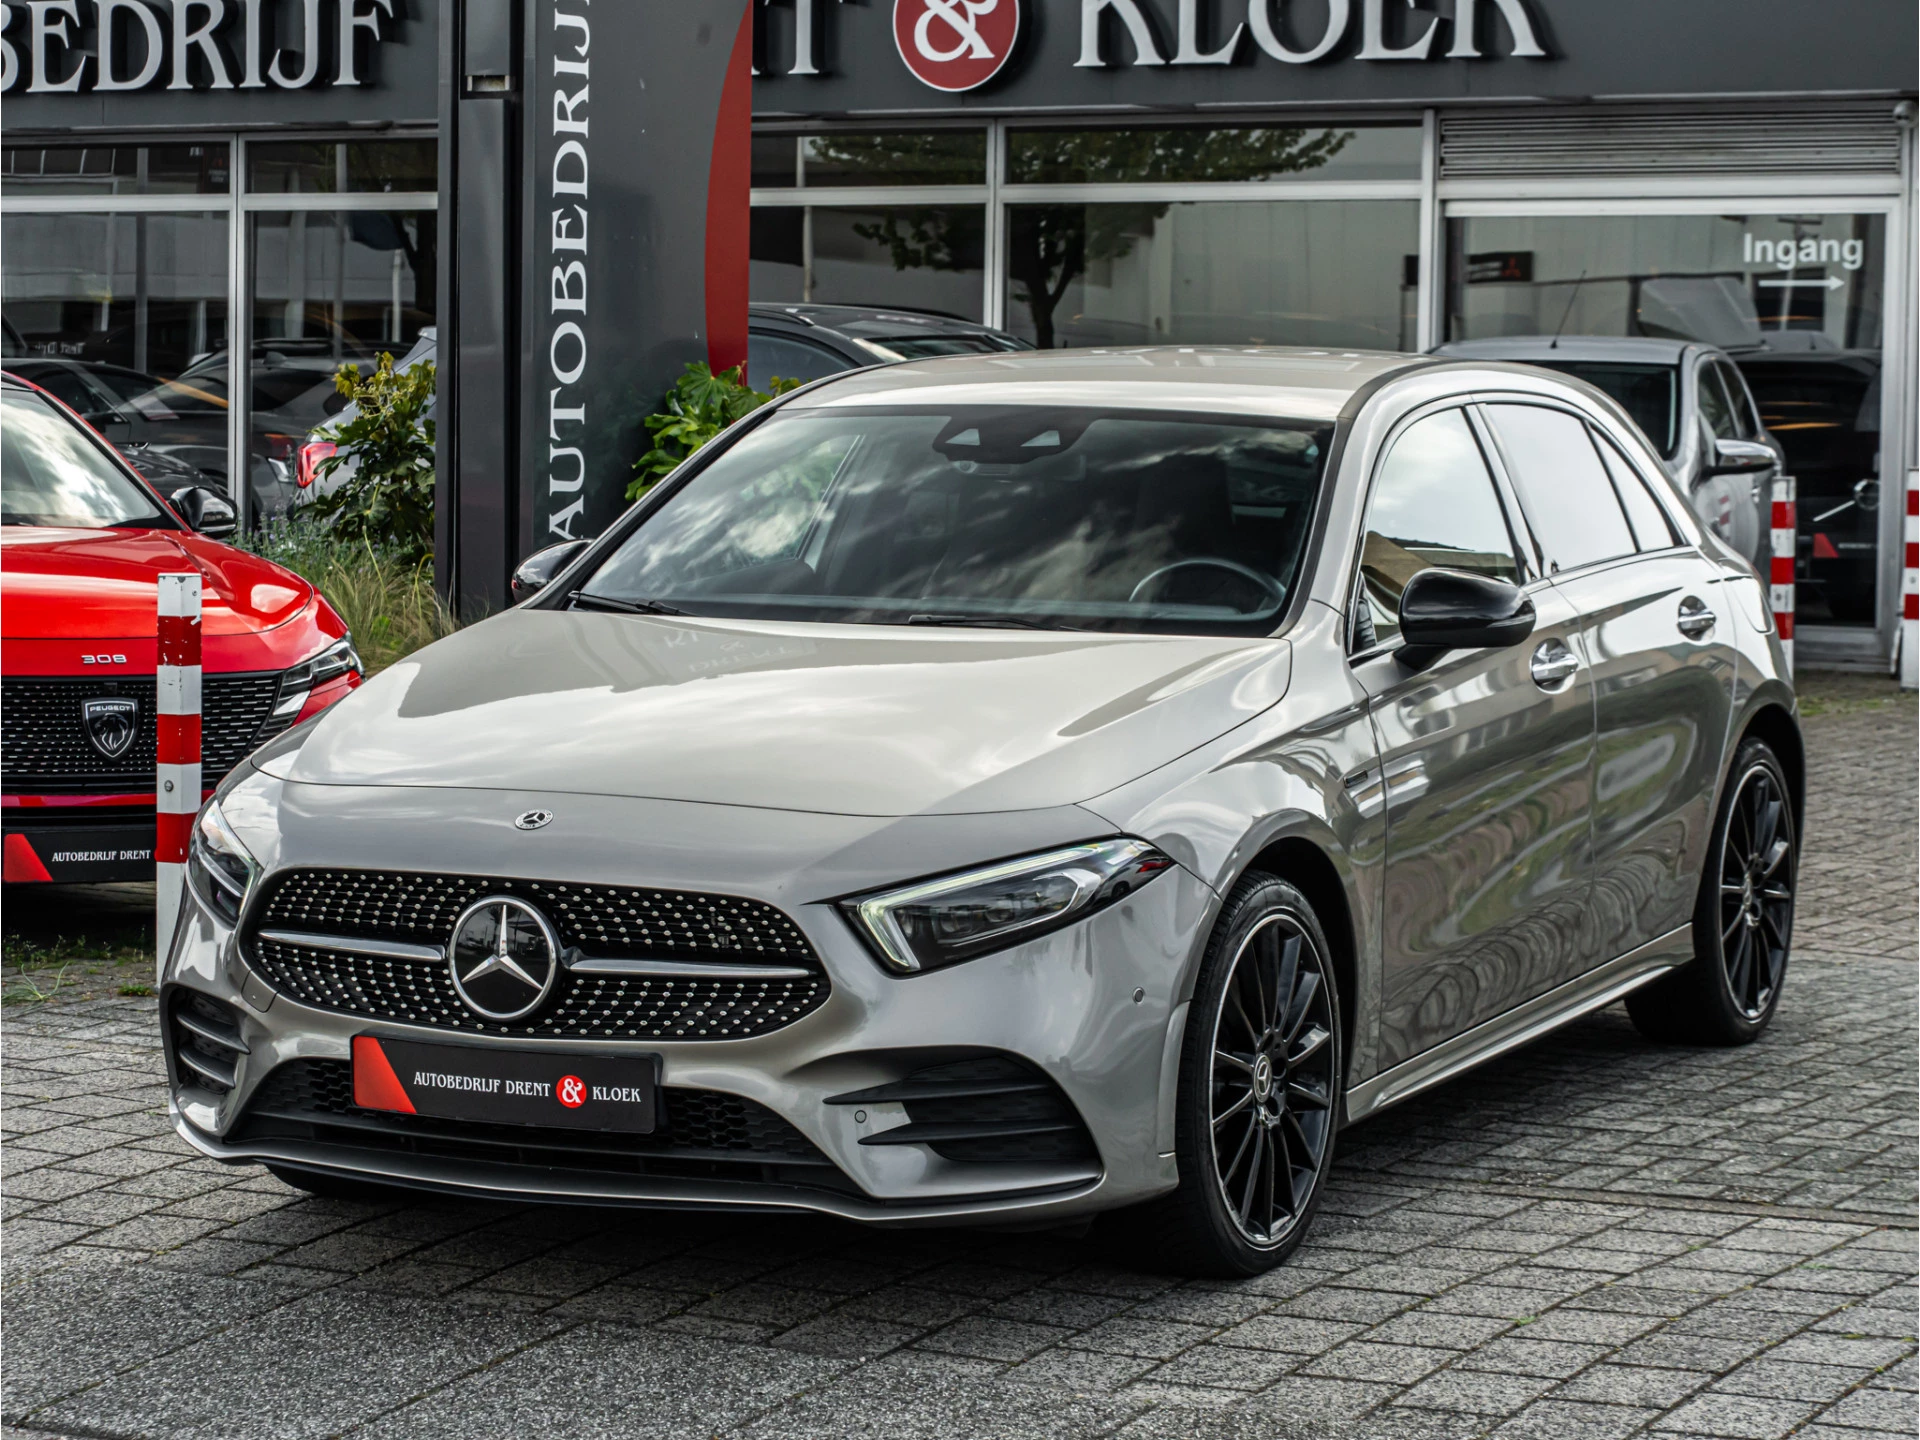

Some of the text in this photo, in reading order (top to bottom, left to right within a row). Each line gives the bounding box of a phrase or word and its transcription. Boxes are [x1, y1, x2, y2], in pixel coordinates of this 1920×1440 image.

[752, 0, 844, 75] T
[1743, 233, 1864, 270] Ingang
[549, 0, 591, 540] AUTOBEDRIJ
[81, 654, 128, 665] 308
[89, 704, 132, 712] PEUGEOT
[52, 849, 151, 862] AUTOBEDRIJF DRENT
[413, 1071, 642, 1104] AUTOBEDRIJF DRENT & KLOEK
